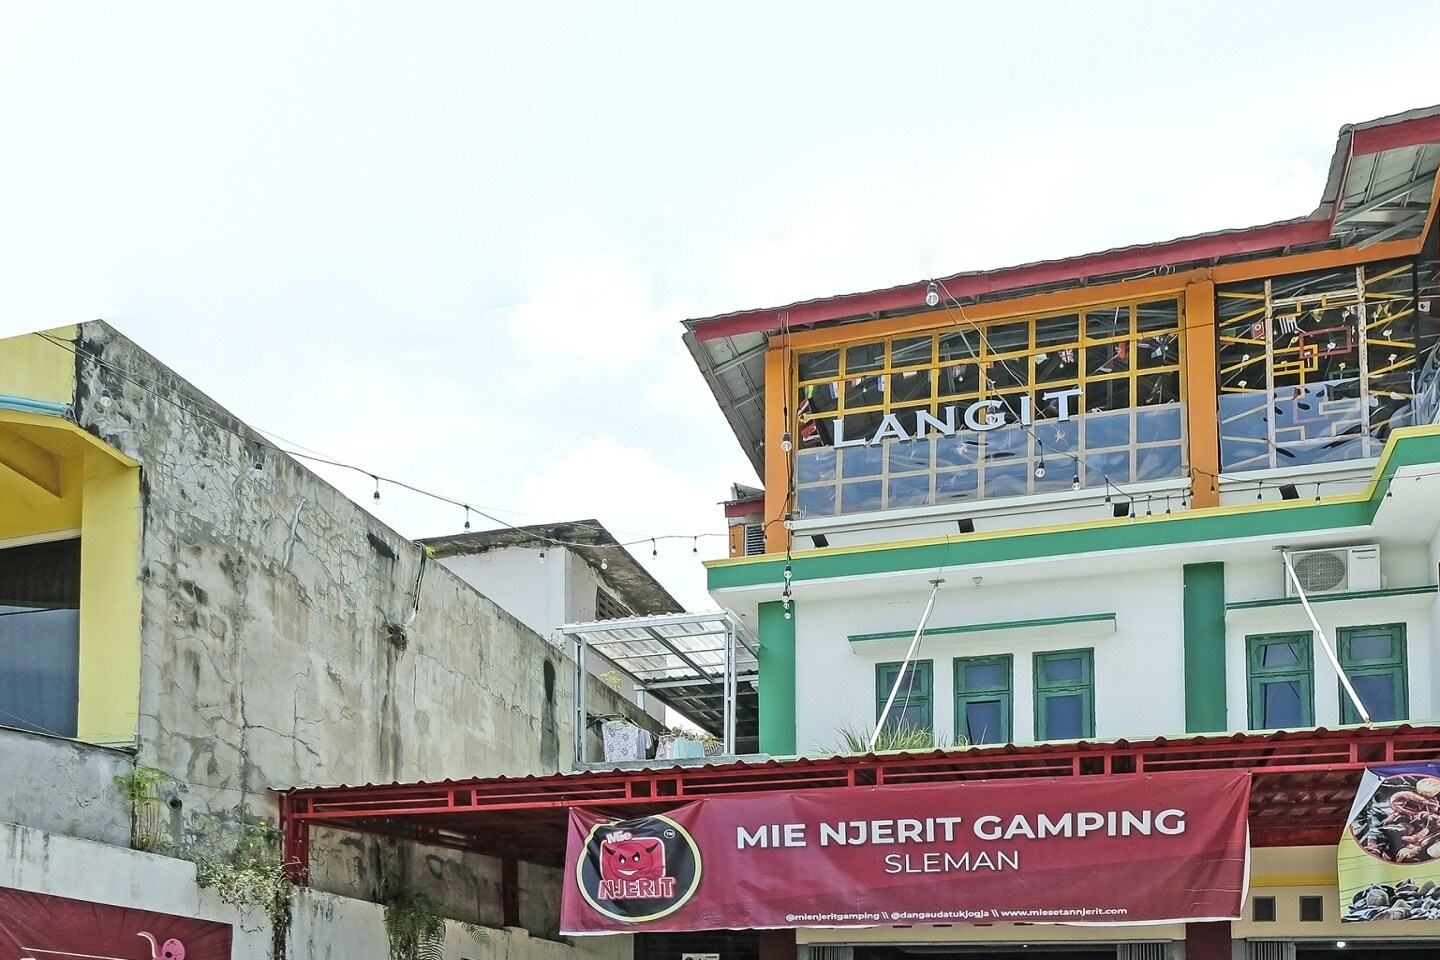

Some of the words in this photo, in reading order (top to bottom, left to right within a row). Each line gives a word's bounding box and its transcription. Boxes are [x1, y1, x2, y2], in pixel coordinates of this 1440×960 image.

[832, 387, 1084, 449] LANGIT
[606, 830, 632, 844] Mie
[736, 823, 807, 849] MIE
[820, 816, 962, 846] NJERIT
[973, 808, 1186, 840] GAMPING
[884, 850, 1019, 874] SLEMAN
[598, 877, 676, 899] NJERIT
[785, 911, 880, 922] @mienjeritgamping
[891, 909, 989, 920] @dangaudatukjogja
[1001, 907, 1128, 917] www.miesetannjerit.com
